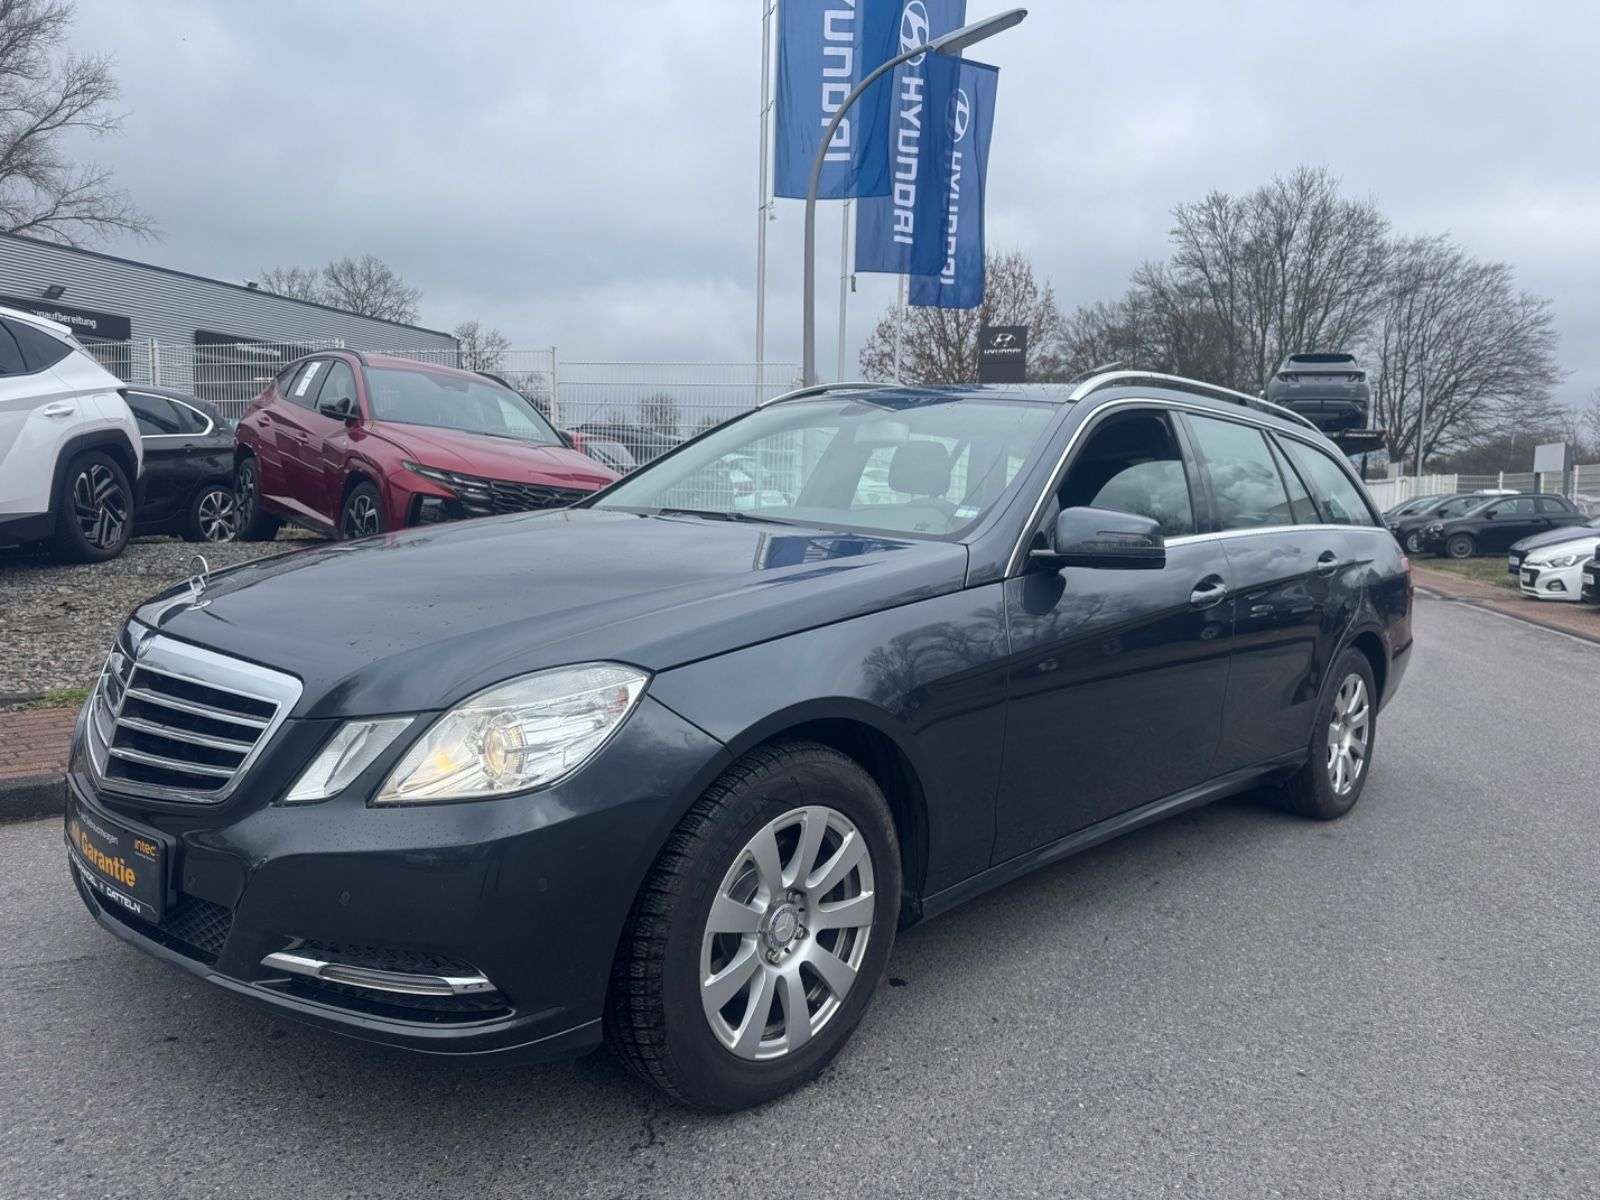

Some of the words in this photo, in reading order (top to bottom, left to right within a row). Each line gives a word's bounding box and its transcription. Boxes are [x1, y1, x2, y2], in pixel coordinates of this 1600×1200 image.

[820, 0, 855, 161] UNDAI
[892, 76, 924, 244] HYUNDAI
[81, 831, 136, 888] Garantie
